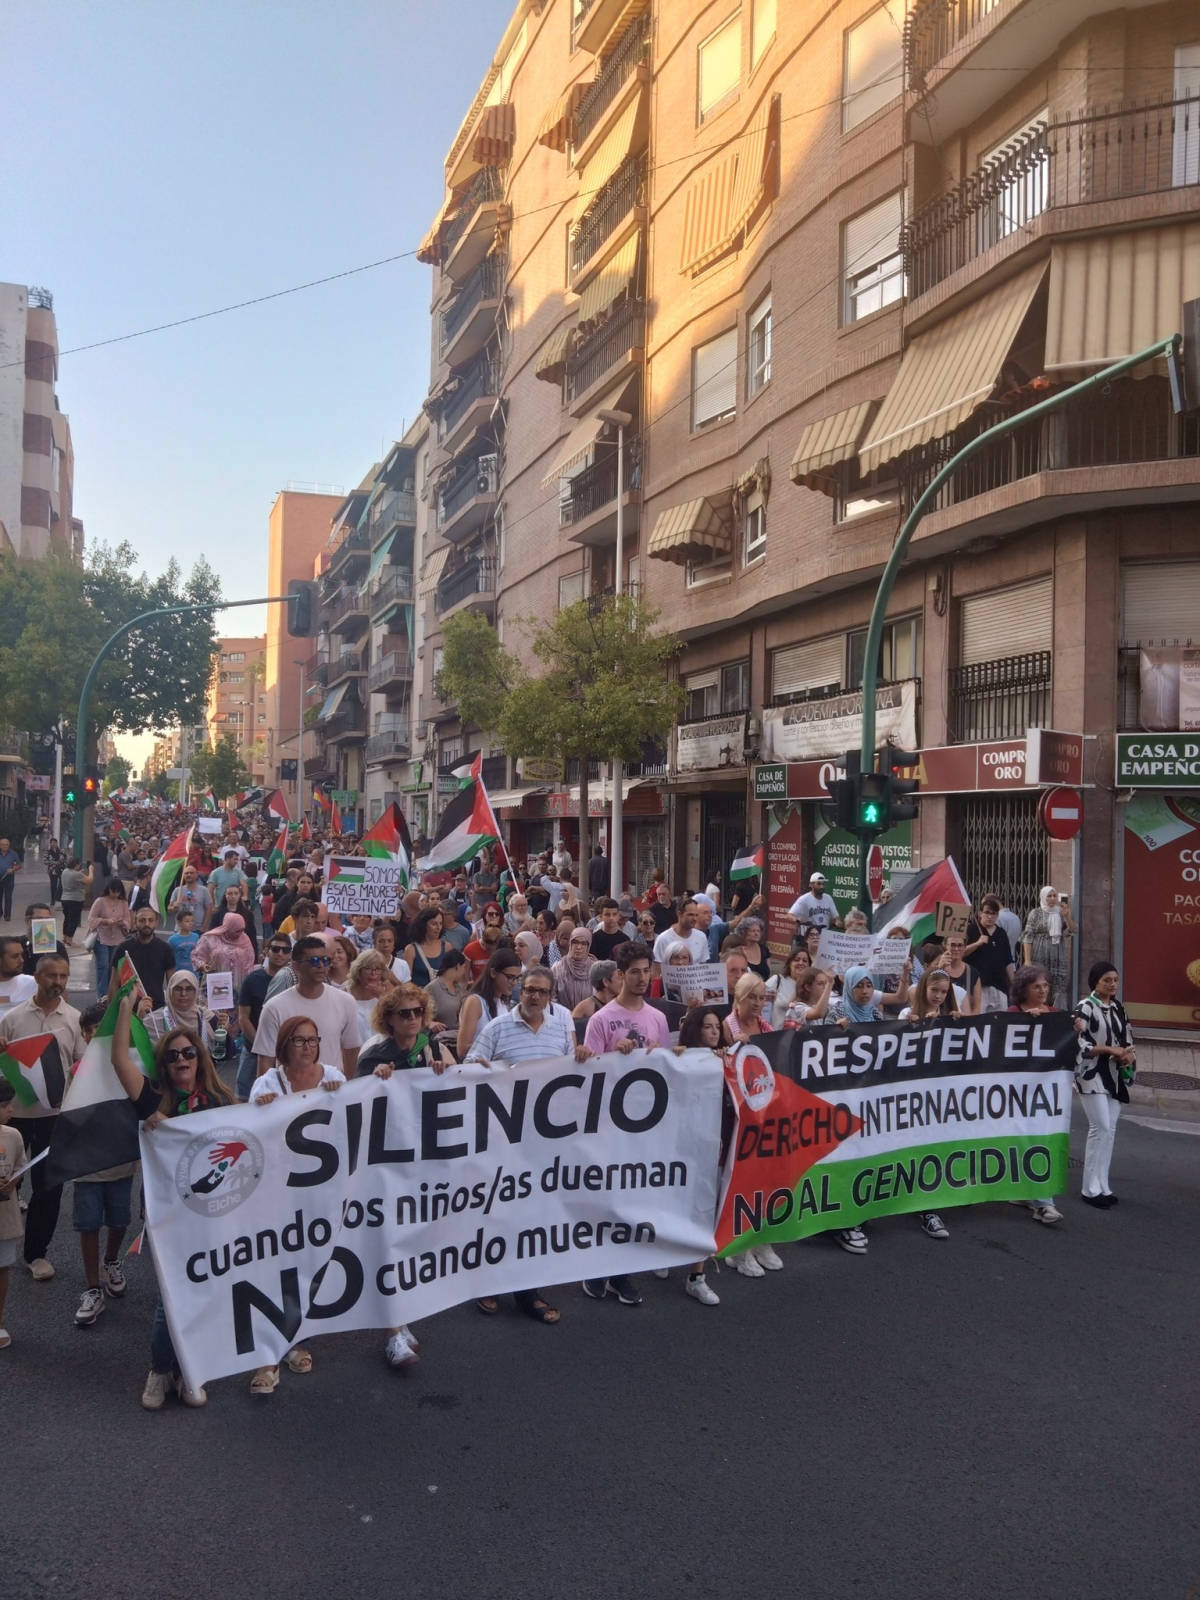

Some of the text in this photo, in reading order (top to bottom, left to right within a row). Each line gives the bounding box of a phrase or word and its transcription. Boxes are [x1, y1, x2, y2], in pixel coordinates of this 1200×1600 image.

[789, 702, 838, 724] ACADEMIA
[841, 691, 894, 715] PORNA
[784, 726, 796, 736] corte
[1128, 744, 1178, 758] CASA
[758, 771, 783, 782] CASA DE
[995, 766, 1022, 779] ORO
[757, 780, 785, 793] EMPEÑOS
[771, 842, 797, 851] EL COMPRO
[1143, 834, 1157, 848] 100
[824, 844, 855, 856] ¿GASTOS
[771, 863, 797, 873] DE EMPEÑO
[821, 856, 856, 868] FINANCIA
[365, 866, 400, 884] SOMOS
[870, 866, 881, 879] STOP
[835, 876, 854, 886] HASTA
[326, 883, 398, 898] ESAS MADRES
[777, 885, 795, 894] ESPAÑA
[326, 896, 396, 914] PALESTINAS
[827, 940, 857, 948] HUMANOS
[820, 953, 836, 961] ALTO
[801, 1024, 992, 1080] RESPETEN
[1004, 1023, 1056, 1058] EL
[285, 1067, 668, 1188] SILENCIO
[736, 1082, 1063, 1162] DERECHO INTERNACIONAL
[178, 1156, 190, 1188] Ayuda
[192, 1130, 234, 1150] Personas
[733, 1145, 1052, 1237] NO AL GENOCIDIO
[207, 1193, 242, 1213] Elche
[185, 1208, 332, 1283] cuando
[396, 1165, 532, 1226] niños/as
[540, 1155, 688, 1194] duerman
[231, 1219, 656, 1356] NO cuando mueran
